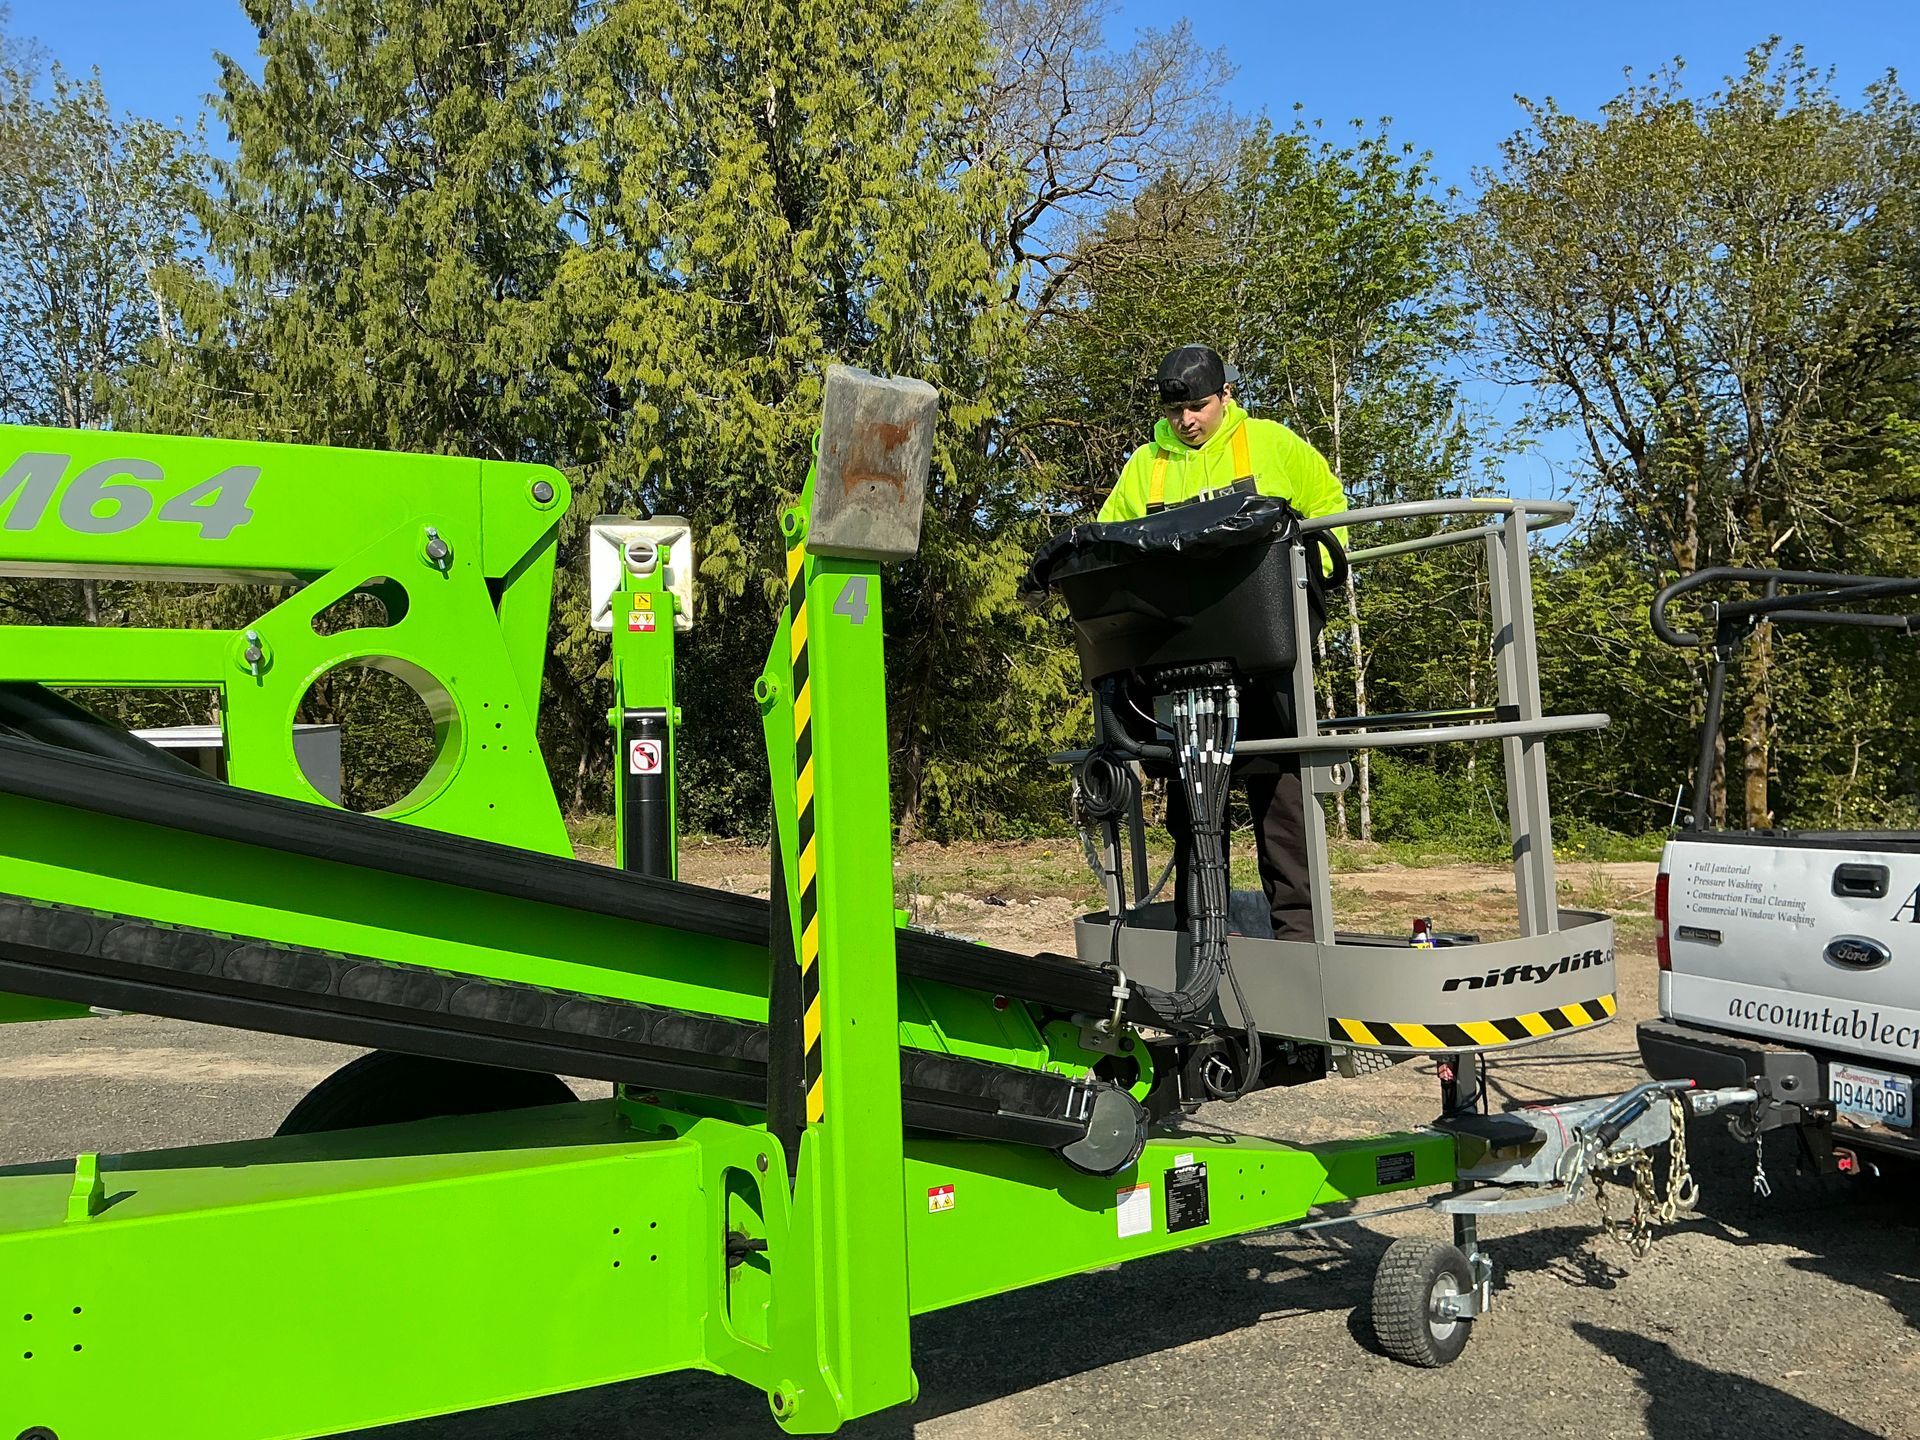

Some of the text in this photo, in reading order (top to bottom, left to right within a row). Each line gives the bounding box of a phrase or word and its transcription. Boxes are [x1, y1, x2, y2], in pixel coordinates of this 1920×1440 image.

[833, 577, 869, 624] 4
[1694, 862, 1751, 875] Full Janitorial
[1693, 876, 1763, 893] Pressure Washing
[1692, 890, 1806, 912] Construction Final Cleaning
[1692, 903, 1816, 928] Commercial Window Washing
[1837, 943, 1871, 962] Ford
[1834, 1071, 1880, 1086] WASHINGTON
[1833, 1080, 1906, 1118] D94430B
